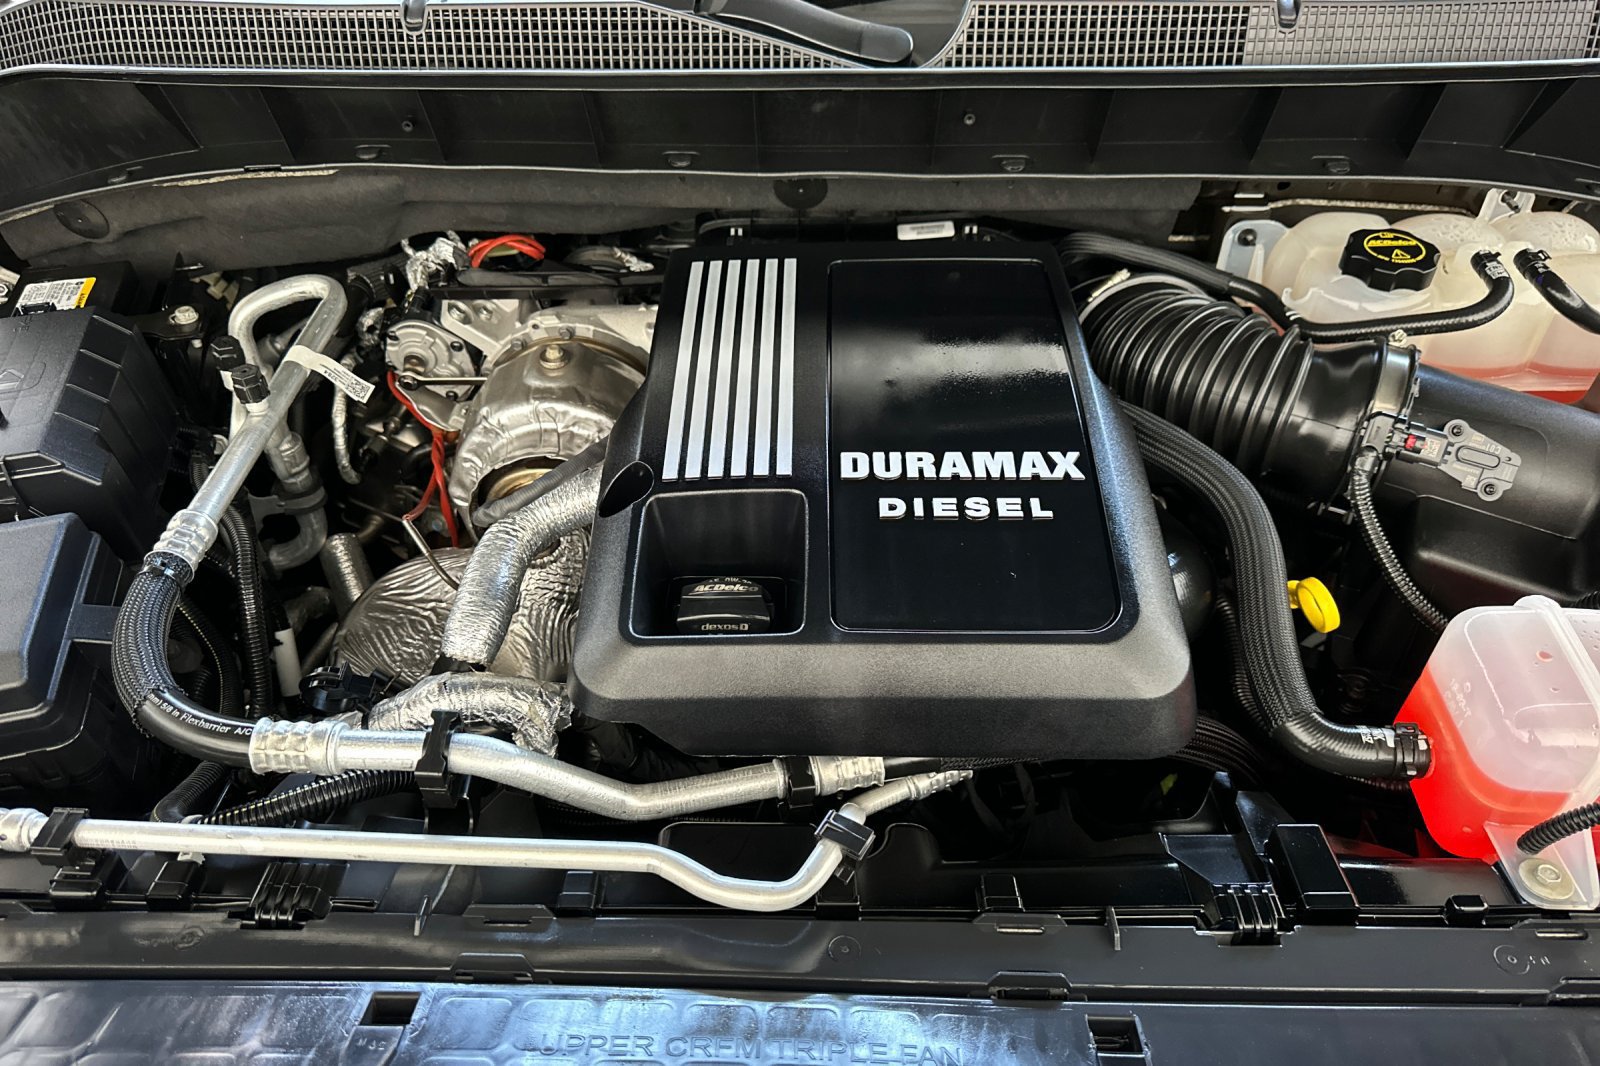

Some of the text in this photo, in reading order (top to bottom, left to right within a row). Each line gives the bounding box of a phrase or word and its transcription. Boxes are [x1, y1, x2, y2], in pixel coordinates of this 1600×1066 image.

[840, 451, 1086, 480] DURAMAX
[879, 497, 1054, 520] DIESEL
[694, 584, 759, 592] ACDelco
[160, 703, 175, 713] 5/8
[181, 712, 231, 733] Flexbarrier
[539, 1033, 655, 1056] UPPER
[770, 1038, 891, 1064] TRIPLE
[900, 1043, 964, 1066] FAN
